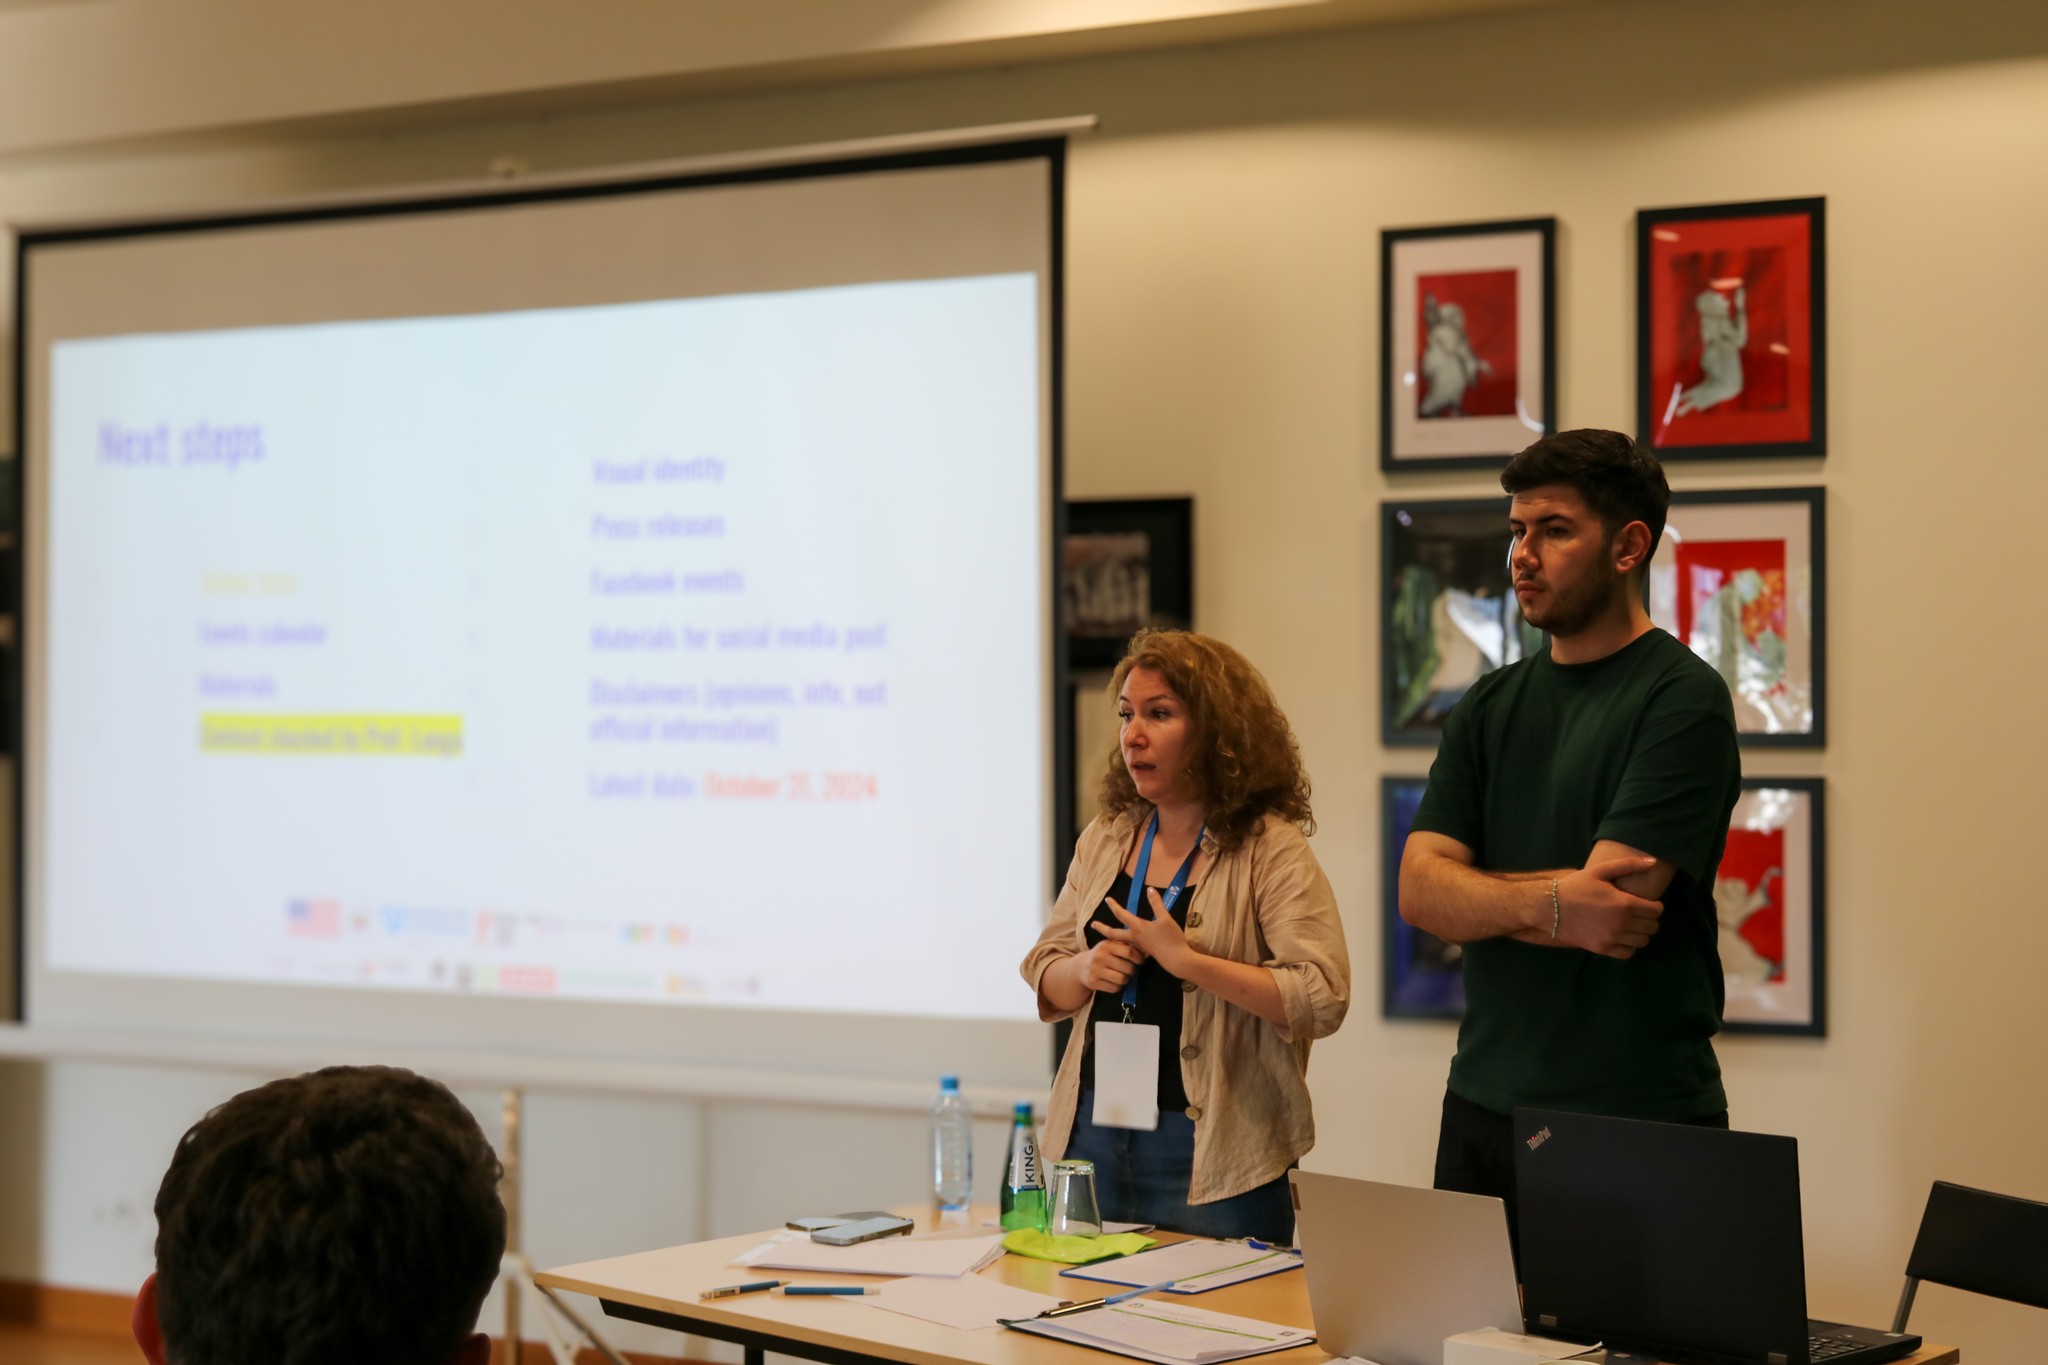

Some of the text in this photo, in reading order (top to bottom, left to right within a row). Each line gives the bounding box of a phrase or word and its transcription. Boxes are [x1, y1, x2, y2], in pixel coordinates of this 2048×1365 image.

[98, 418, 265, 472] Next steps
[593, 454, 727, 485] Visual identity
[591, 512, 726, 540] Press releases
[590, 567, 744, 595] Facebook events
[589, 623, 676, 650] Materials
[683, 623, 708, 649] for
[717, 622, 771, 649] social
[778, 621, 836, 647] media
[590, 677, 698, 704] Disclaimers
[590, 714, 779, 747] official information)
[587, 770, 646, 797] Latest
[705, 771, 780, 797] October
[822, 772, 879, 799] 2024
[1526, 1125, 1552, 1151] ThinkPad
